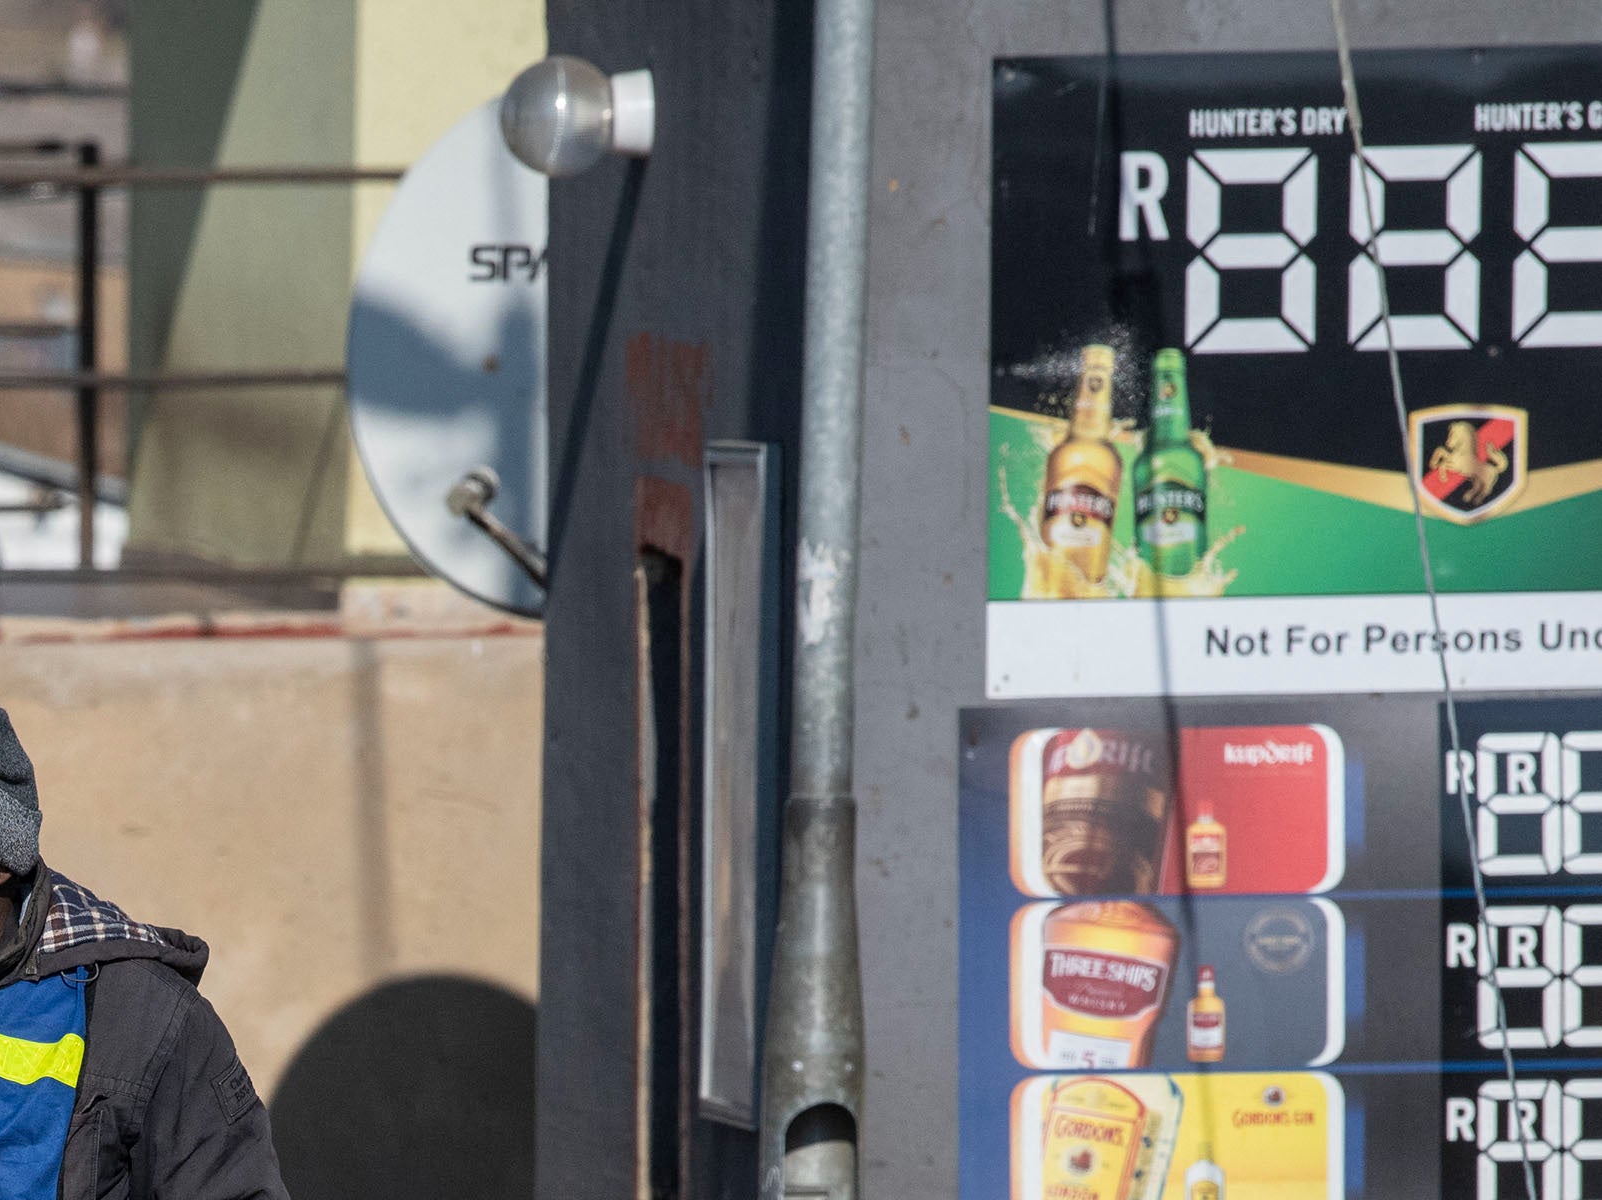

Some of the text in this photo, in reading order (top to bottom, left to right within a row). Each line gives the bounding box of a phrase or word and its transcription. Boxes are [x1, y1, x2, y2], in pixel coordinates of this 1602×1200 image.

[1189, 106, 1348, 138] HUNTER'S DRY
[1474, 101, 1583, 132] HUNTER'S
[1119, 151, 1170, 241] R
[1205, 626, 1270, 656] Not
[1286, 624, 1349, 655] For
[1363, 622, 1522, 655] Persons
[1051, 951, 1102, 978] THREE
[1105, 960, 1158, 992] SHIPS
